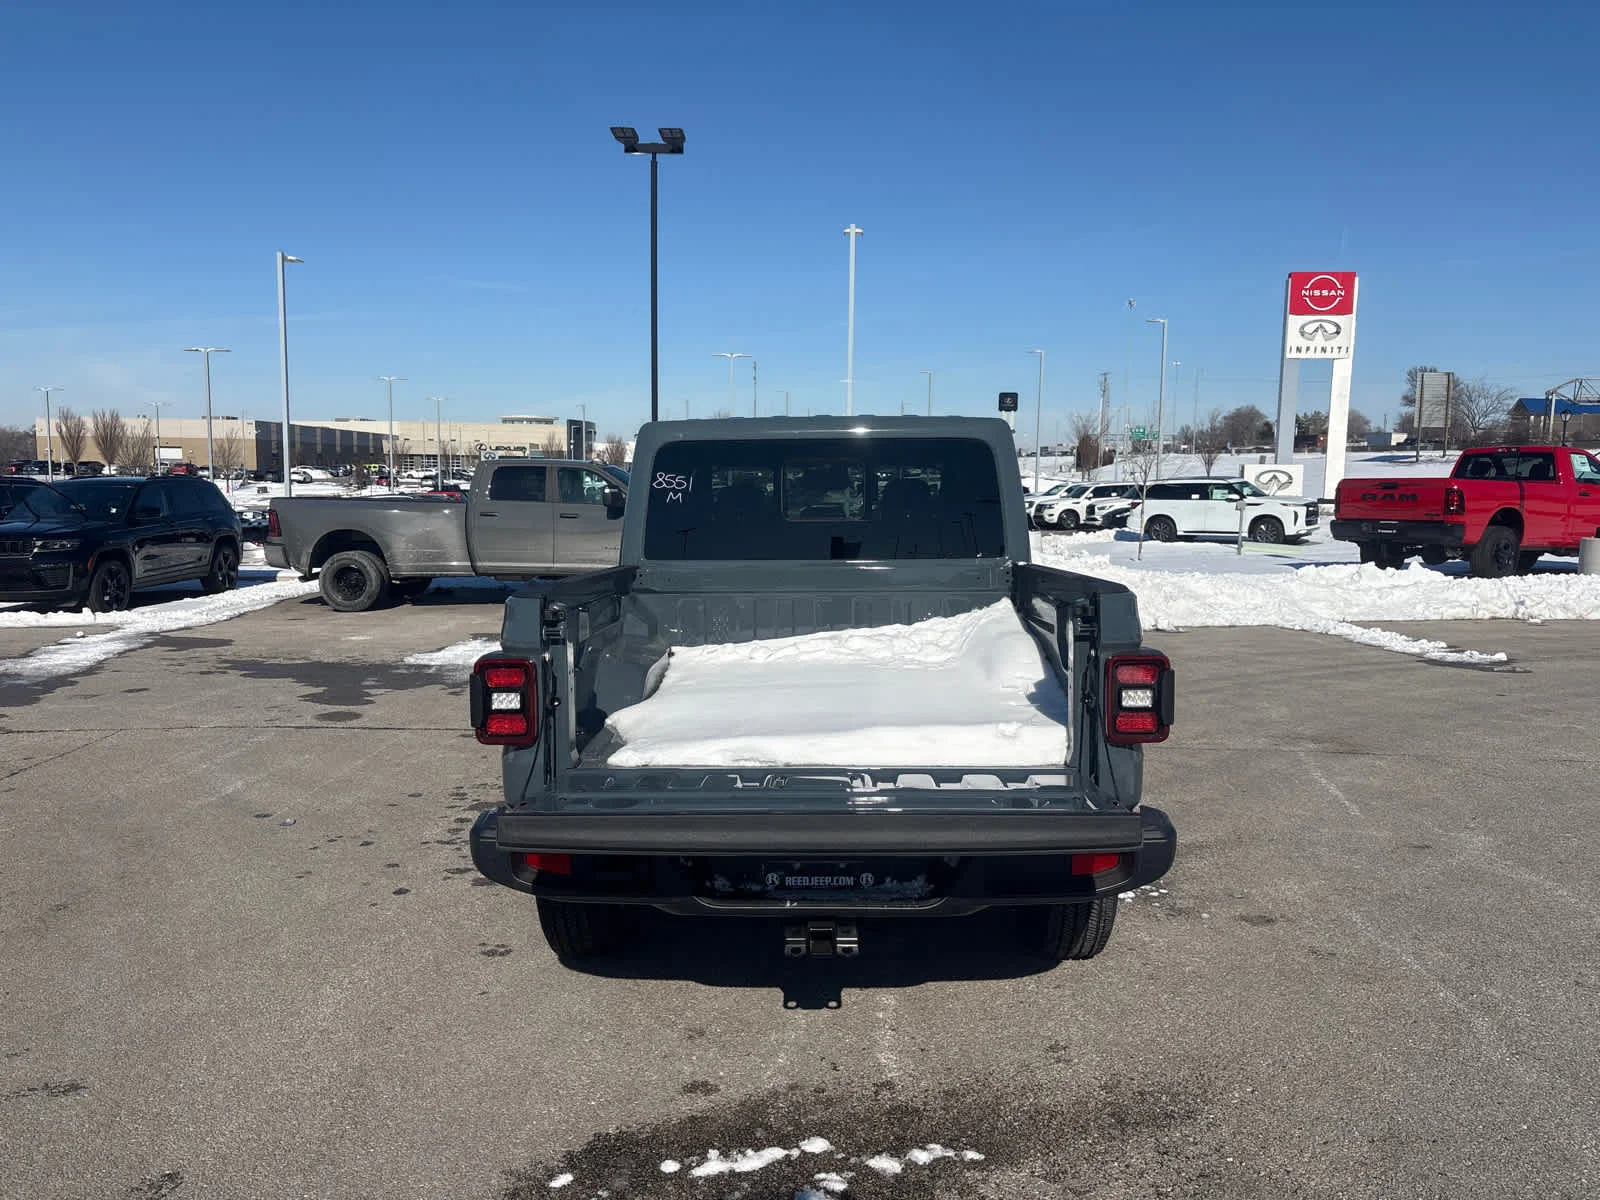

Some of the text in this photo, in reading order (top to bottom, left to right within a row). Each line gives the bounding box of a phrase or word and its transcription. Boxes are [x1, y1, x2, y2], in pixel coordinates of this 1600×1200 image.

[1301, 289, 1345, 297] NISSAN
[1288, 345, 1349, 354] INFINITI
[652, 471, 693, 492] 8551
[666, 491, 682, 503] M
[1361, 493, 1418, 502] RAM
[785, 876, 855, 887] REEDJEEP.COM
